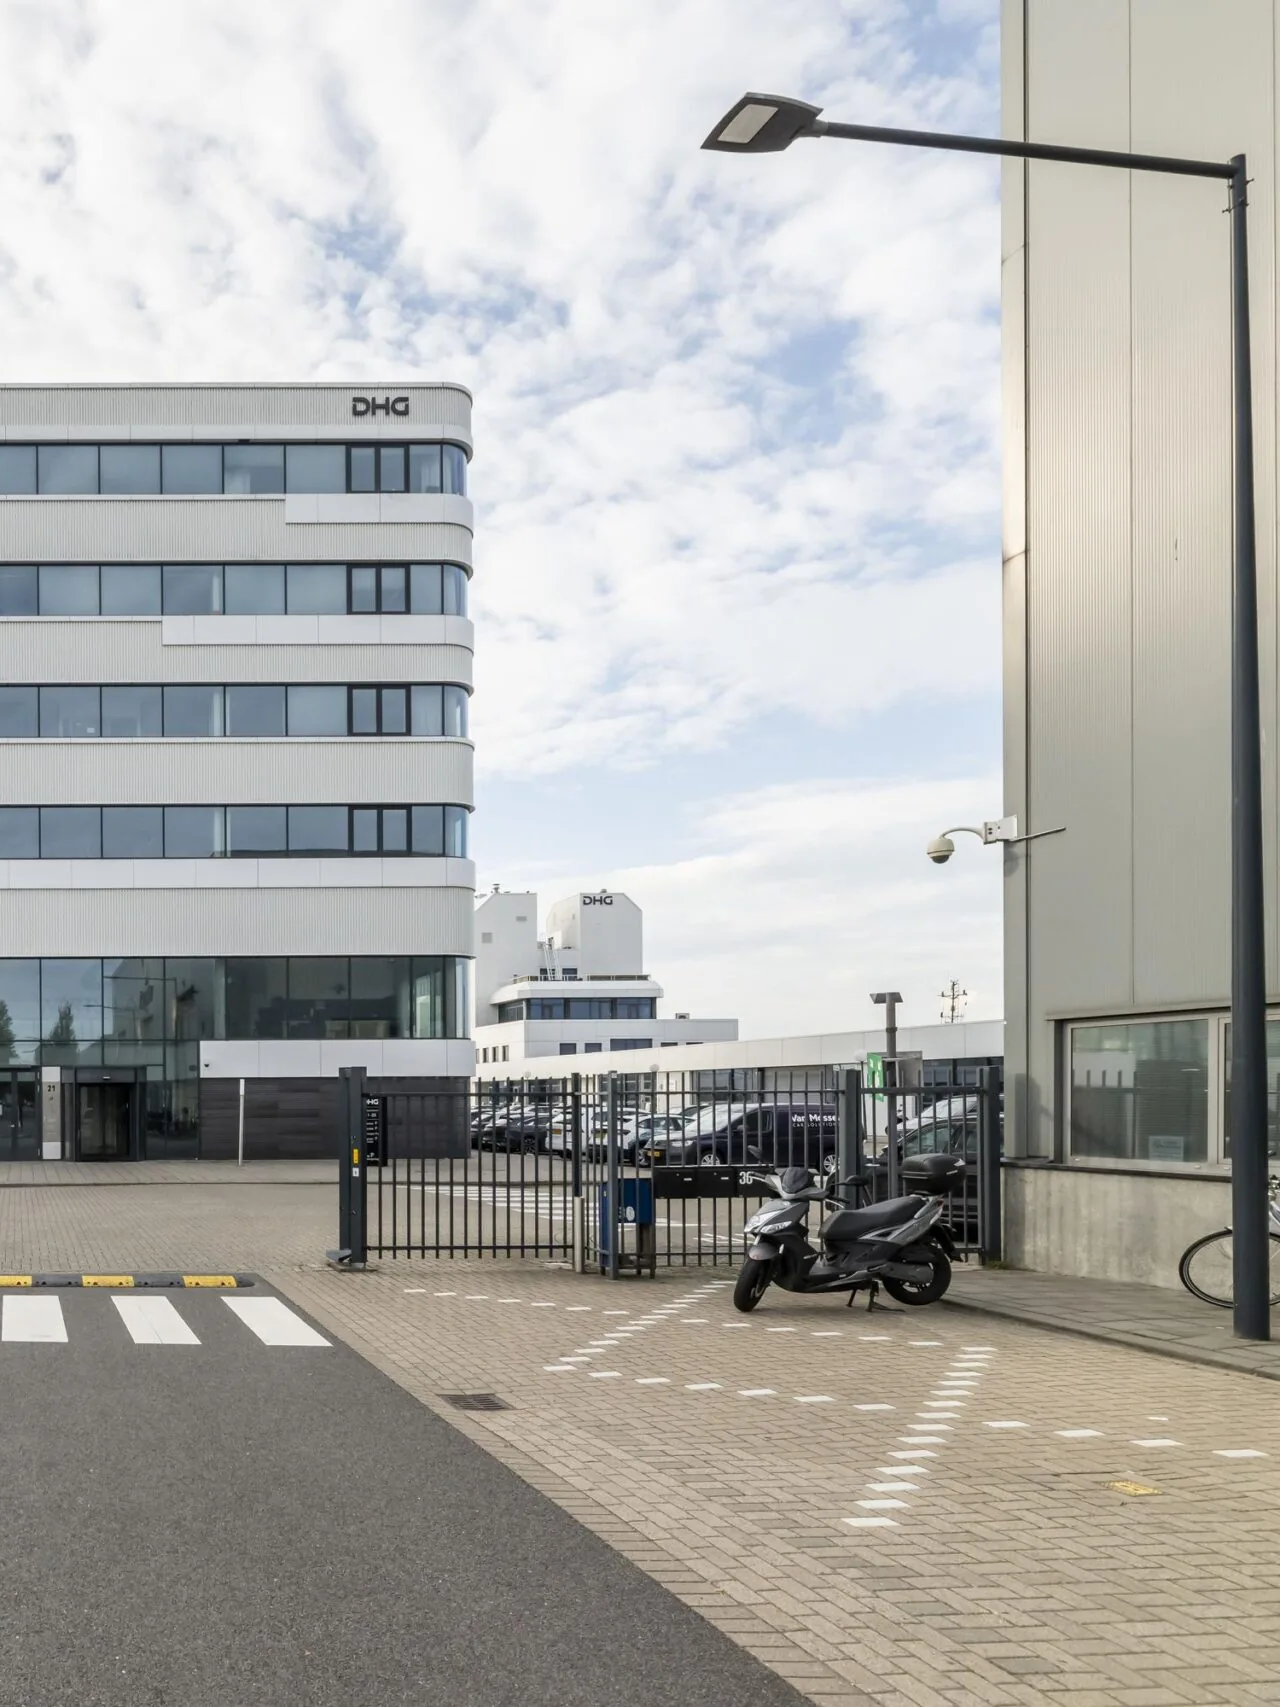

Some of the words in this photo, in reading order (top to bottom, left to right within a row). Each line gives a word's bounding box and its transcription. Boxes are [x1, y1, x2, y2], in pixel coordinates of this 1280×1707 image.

[352, 396, 410, 416] DHG
[583, 895, 613, 906] DHG
[739, 1171, 753, 1184] 36
